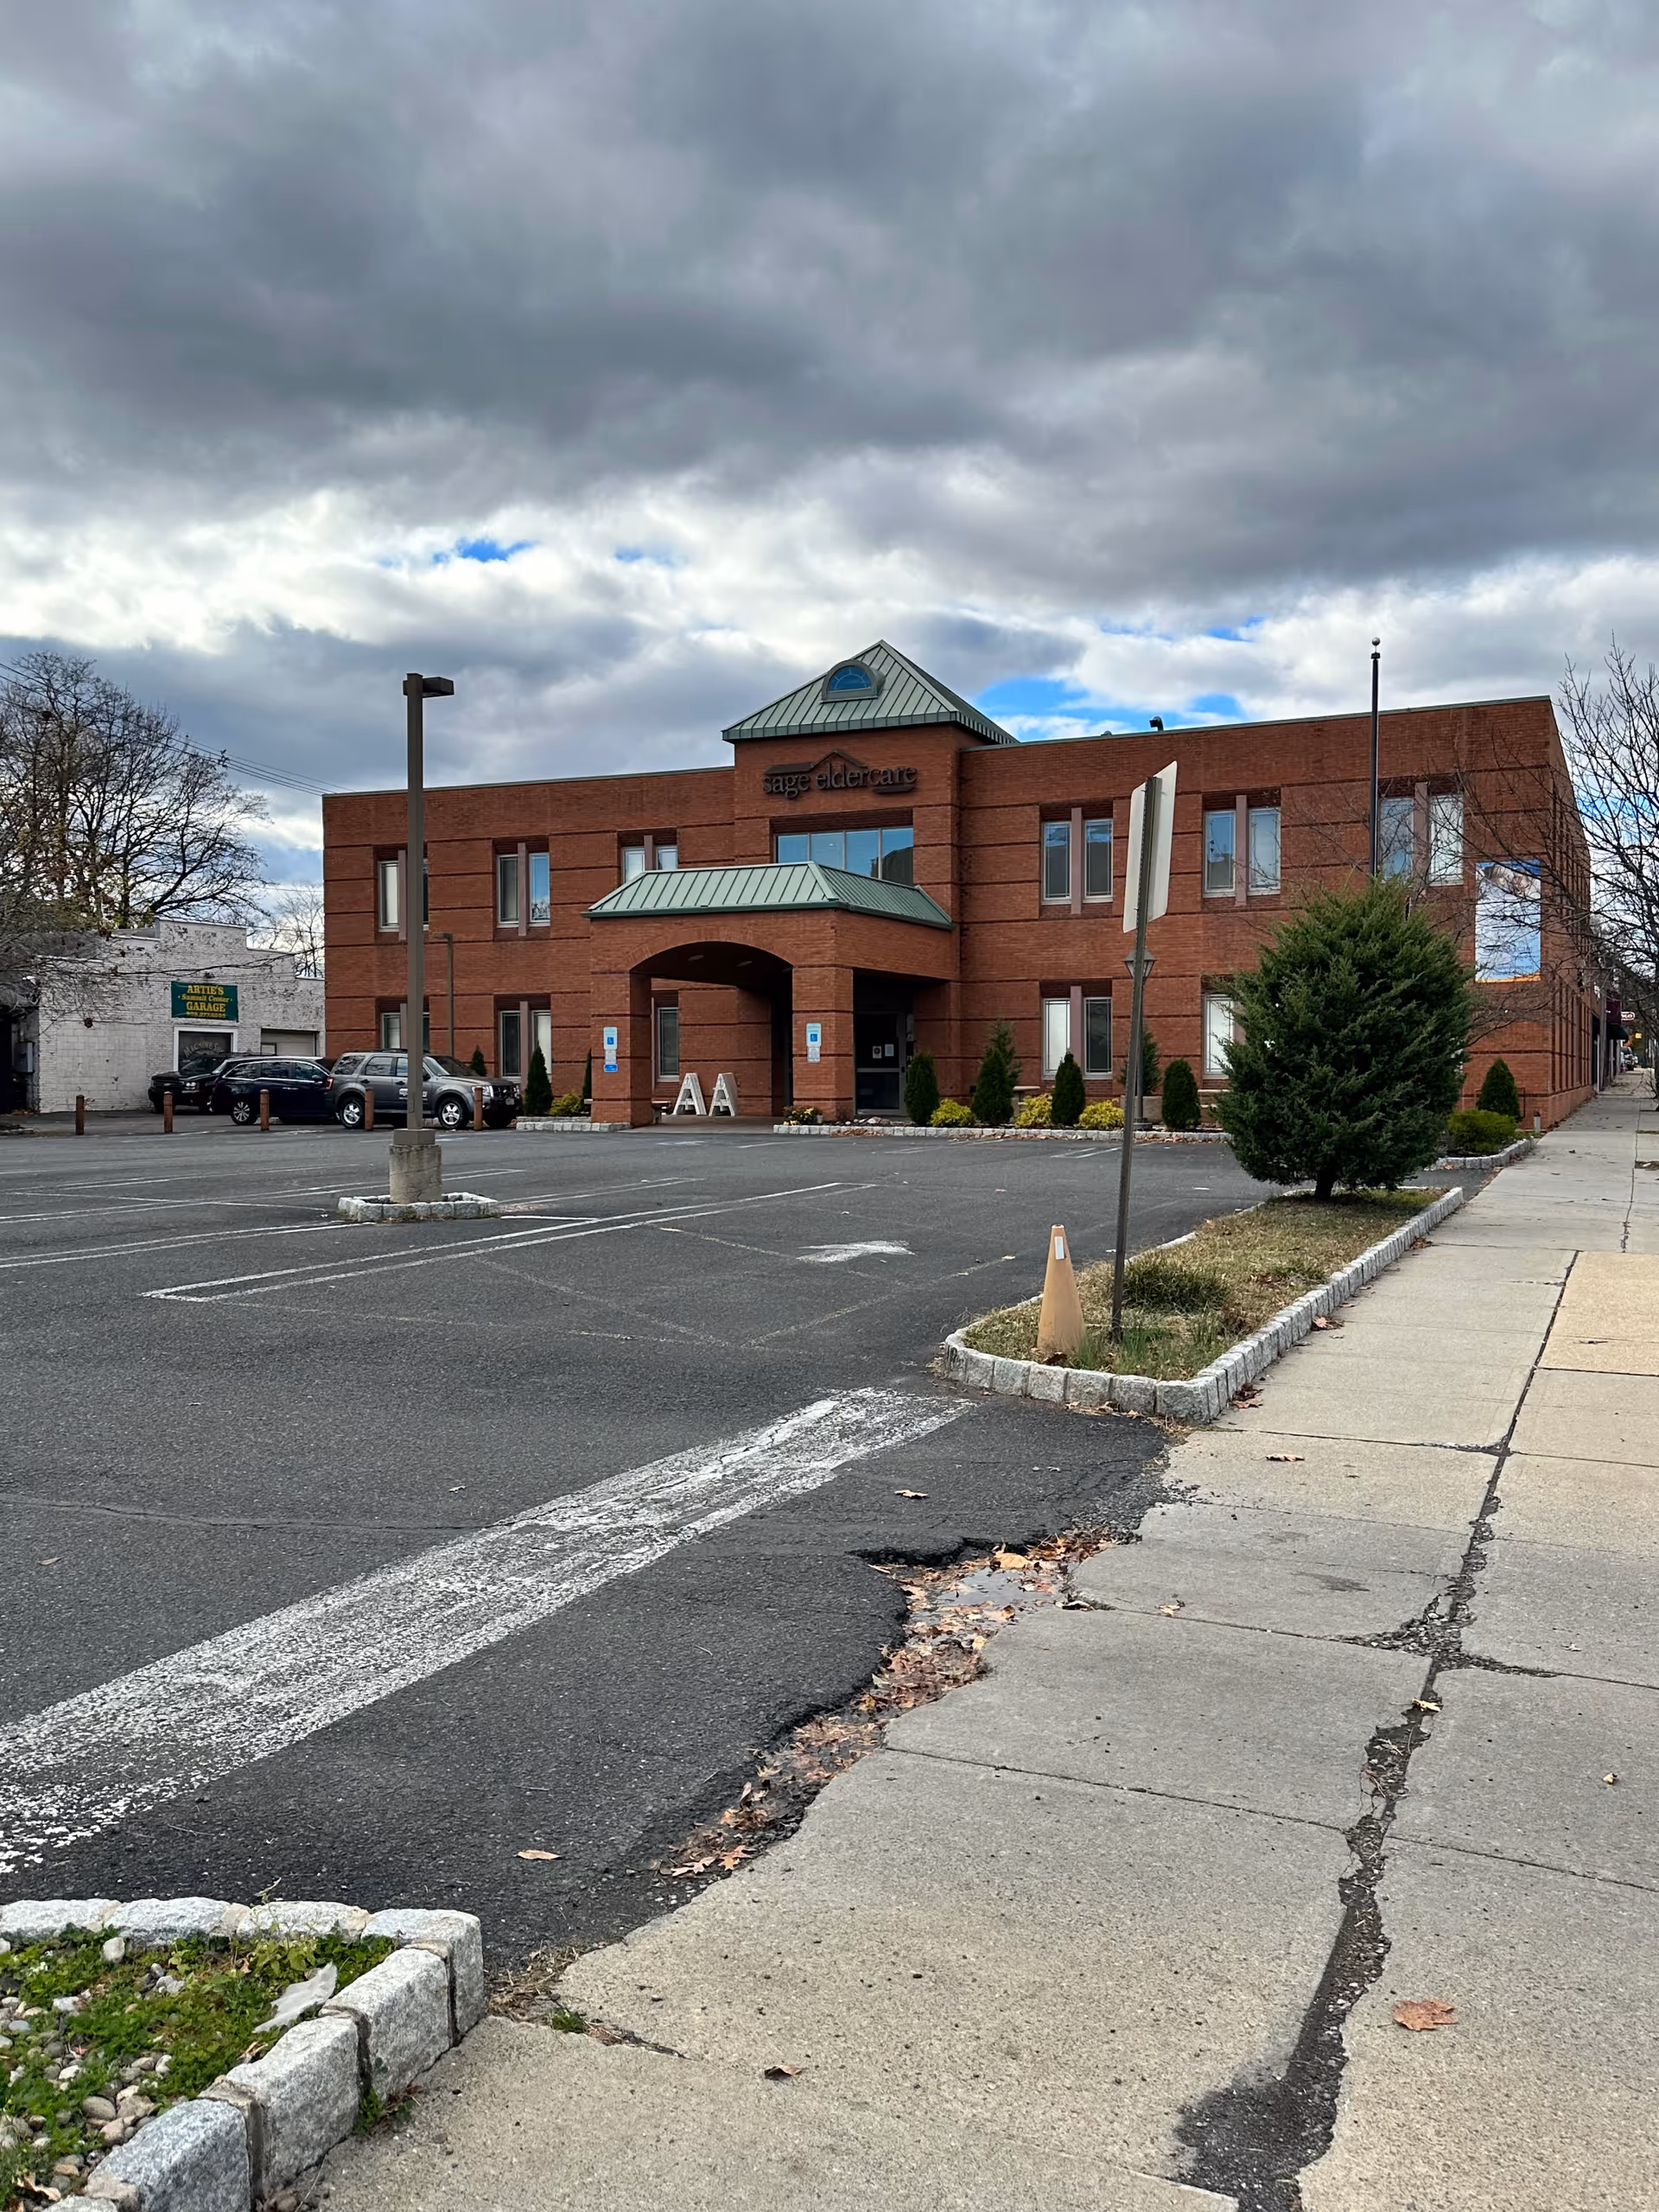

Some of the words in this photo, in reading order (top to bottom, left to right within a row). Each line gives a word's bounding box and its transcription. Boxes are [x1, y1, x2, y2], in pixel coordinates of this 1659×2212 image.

[763, 772, 810, 799] sage
[815, 763, 917, 790] eldercare
[188, 985, 224, 995] ARTIE'S
[187, 1001, 226, 1012] GARAGE
